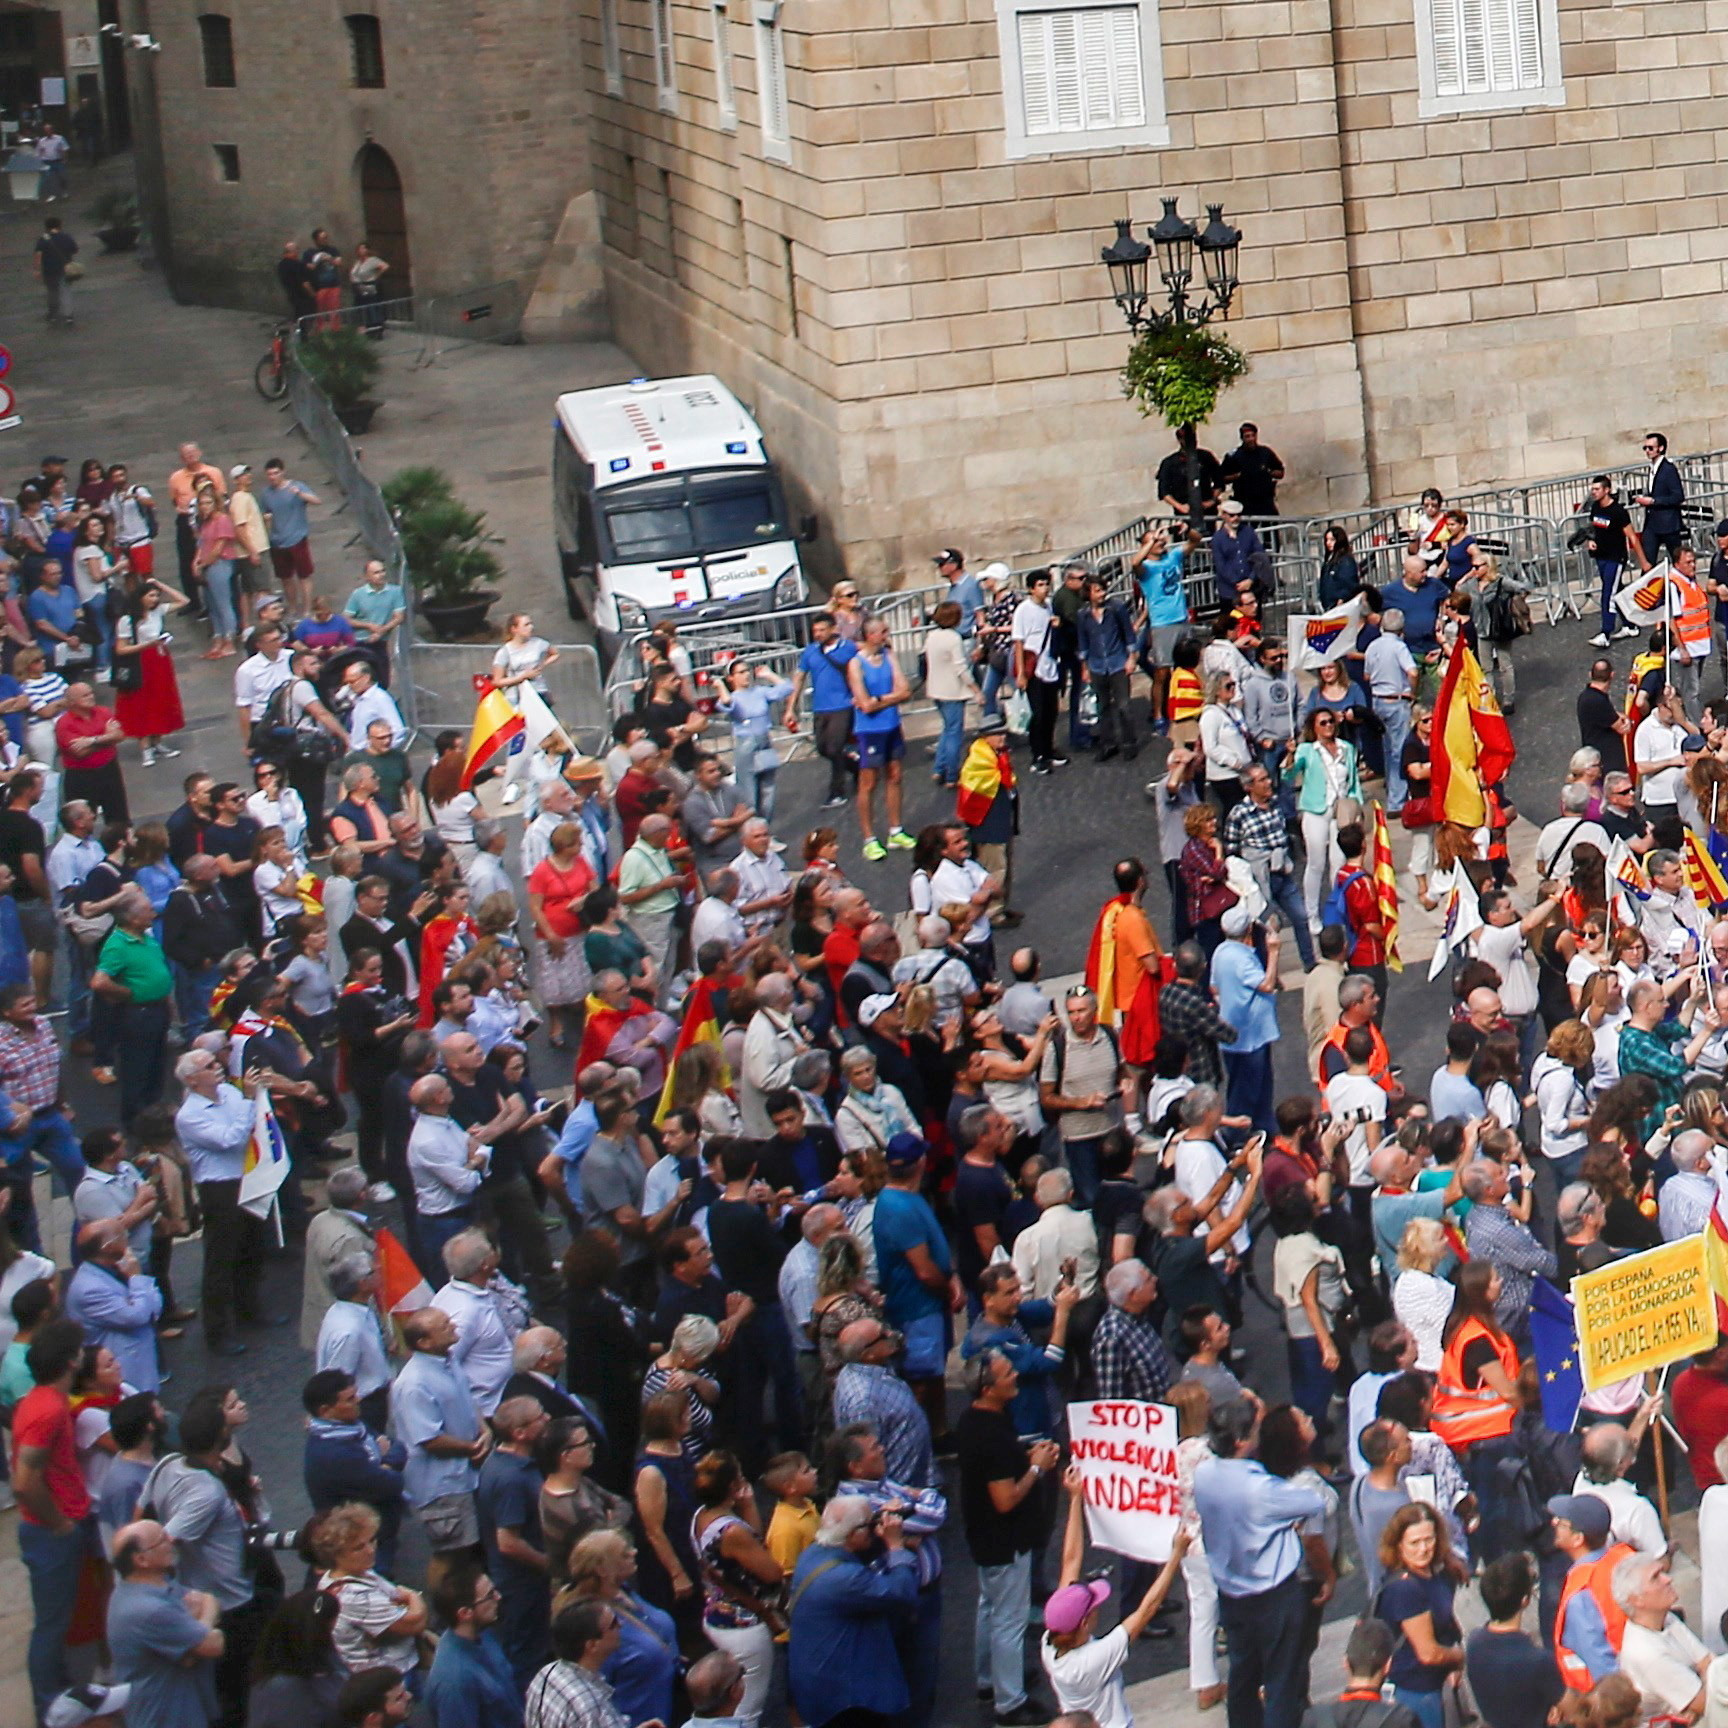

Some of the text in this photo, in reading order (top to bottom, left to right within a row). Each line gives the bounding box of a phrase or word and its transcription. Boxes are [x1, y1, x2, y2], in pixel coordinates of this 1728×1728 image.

[1584, 1285, 1608, 1301] POR
[1586, 1266, 1700, 1316] POR LA DEMOCRACIA
[1588, 1315, 1612, 1332] POR
[1614, 1308, 1629, 1322] LA
[1088, 1403, 1163, 1434] STOP
[1070, 1438, 1178, 1480] VIOLENCIA
